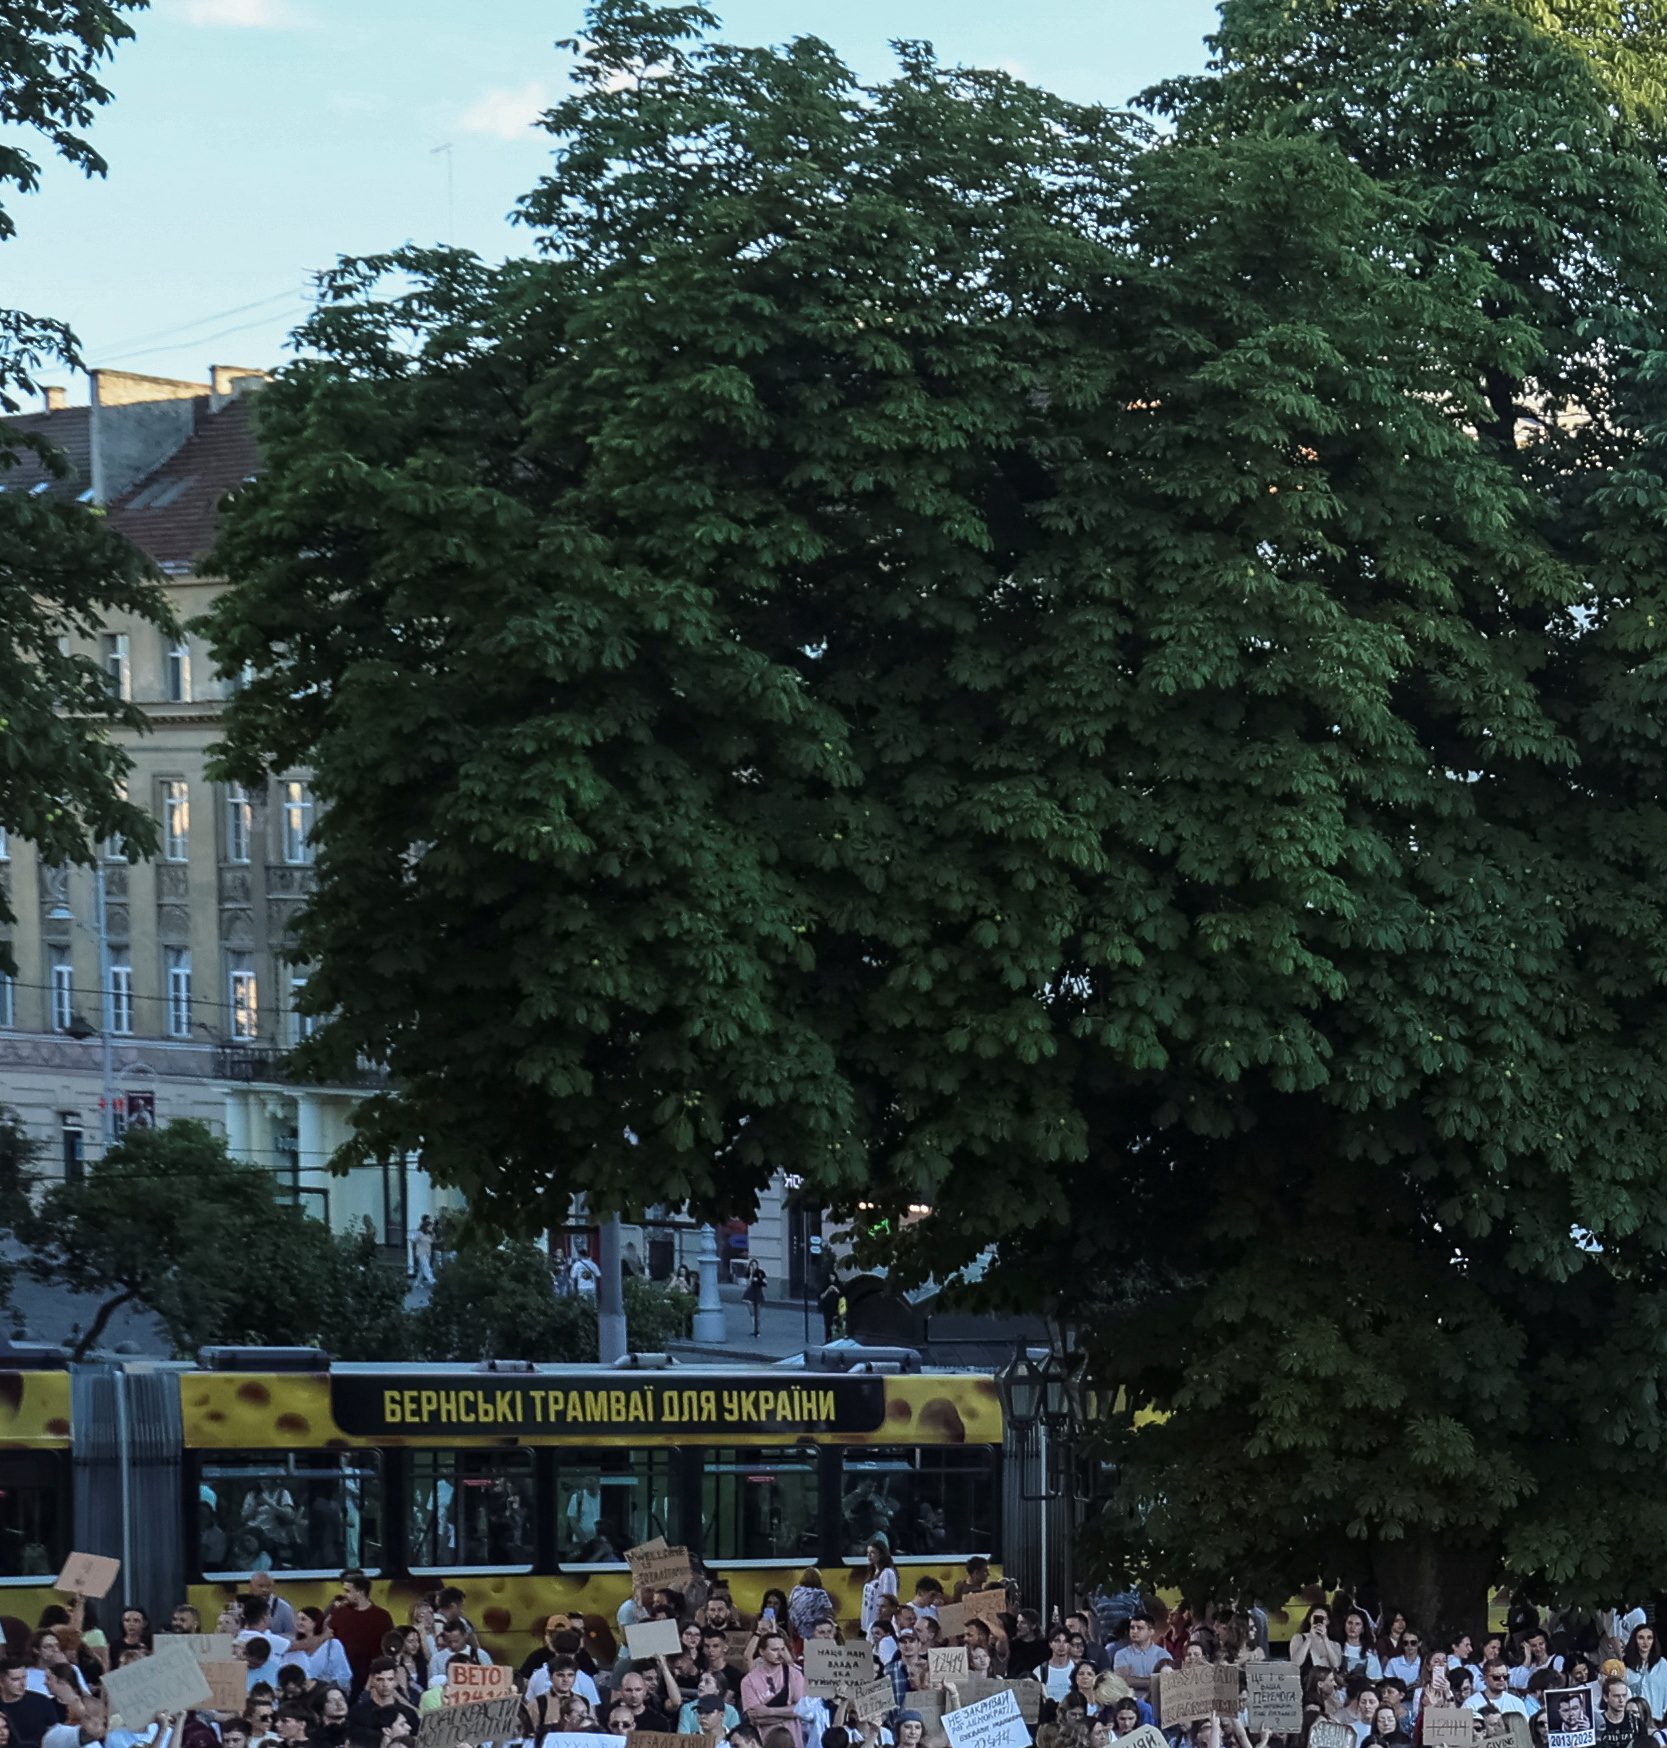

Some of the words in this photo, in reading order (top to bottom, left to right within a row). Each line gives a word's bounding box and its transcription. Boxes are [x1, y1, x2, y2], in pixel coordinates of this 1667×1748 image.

[383, 1390, 522, 1422] БЕРНСЬКІ
[530, 1386, 653, 1422] ТРАМВАЇ
[662, 1390, 717, 1422] ДЛЯ
[723, 1386, 835, 1422] УКРАЇНИ
[453, 1667, 500, 1688] ВЕТО
